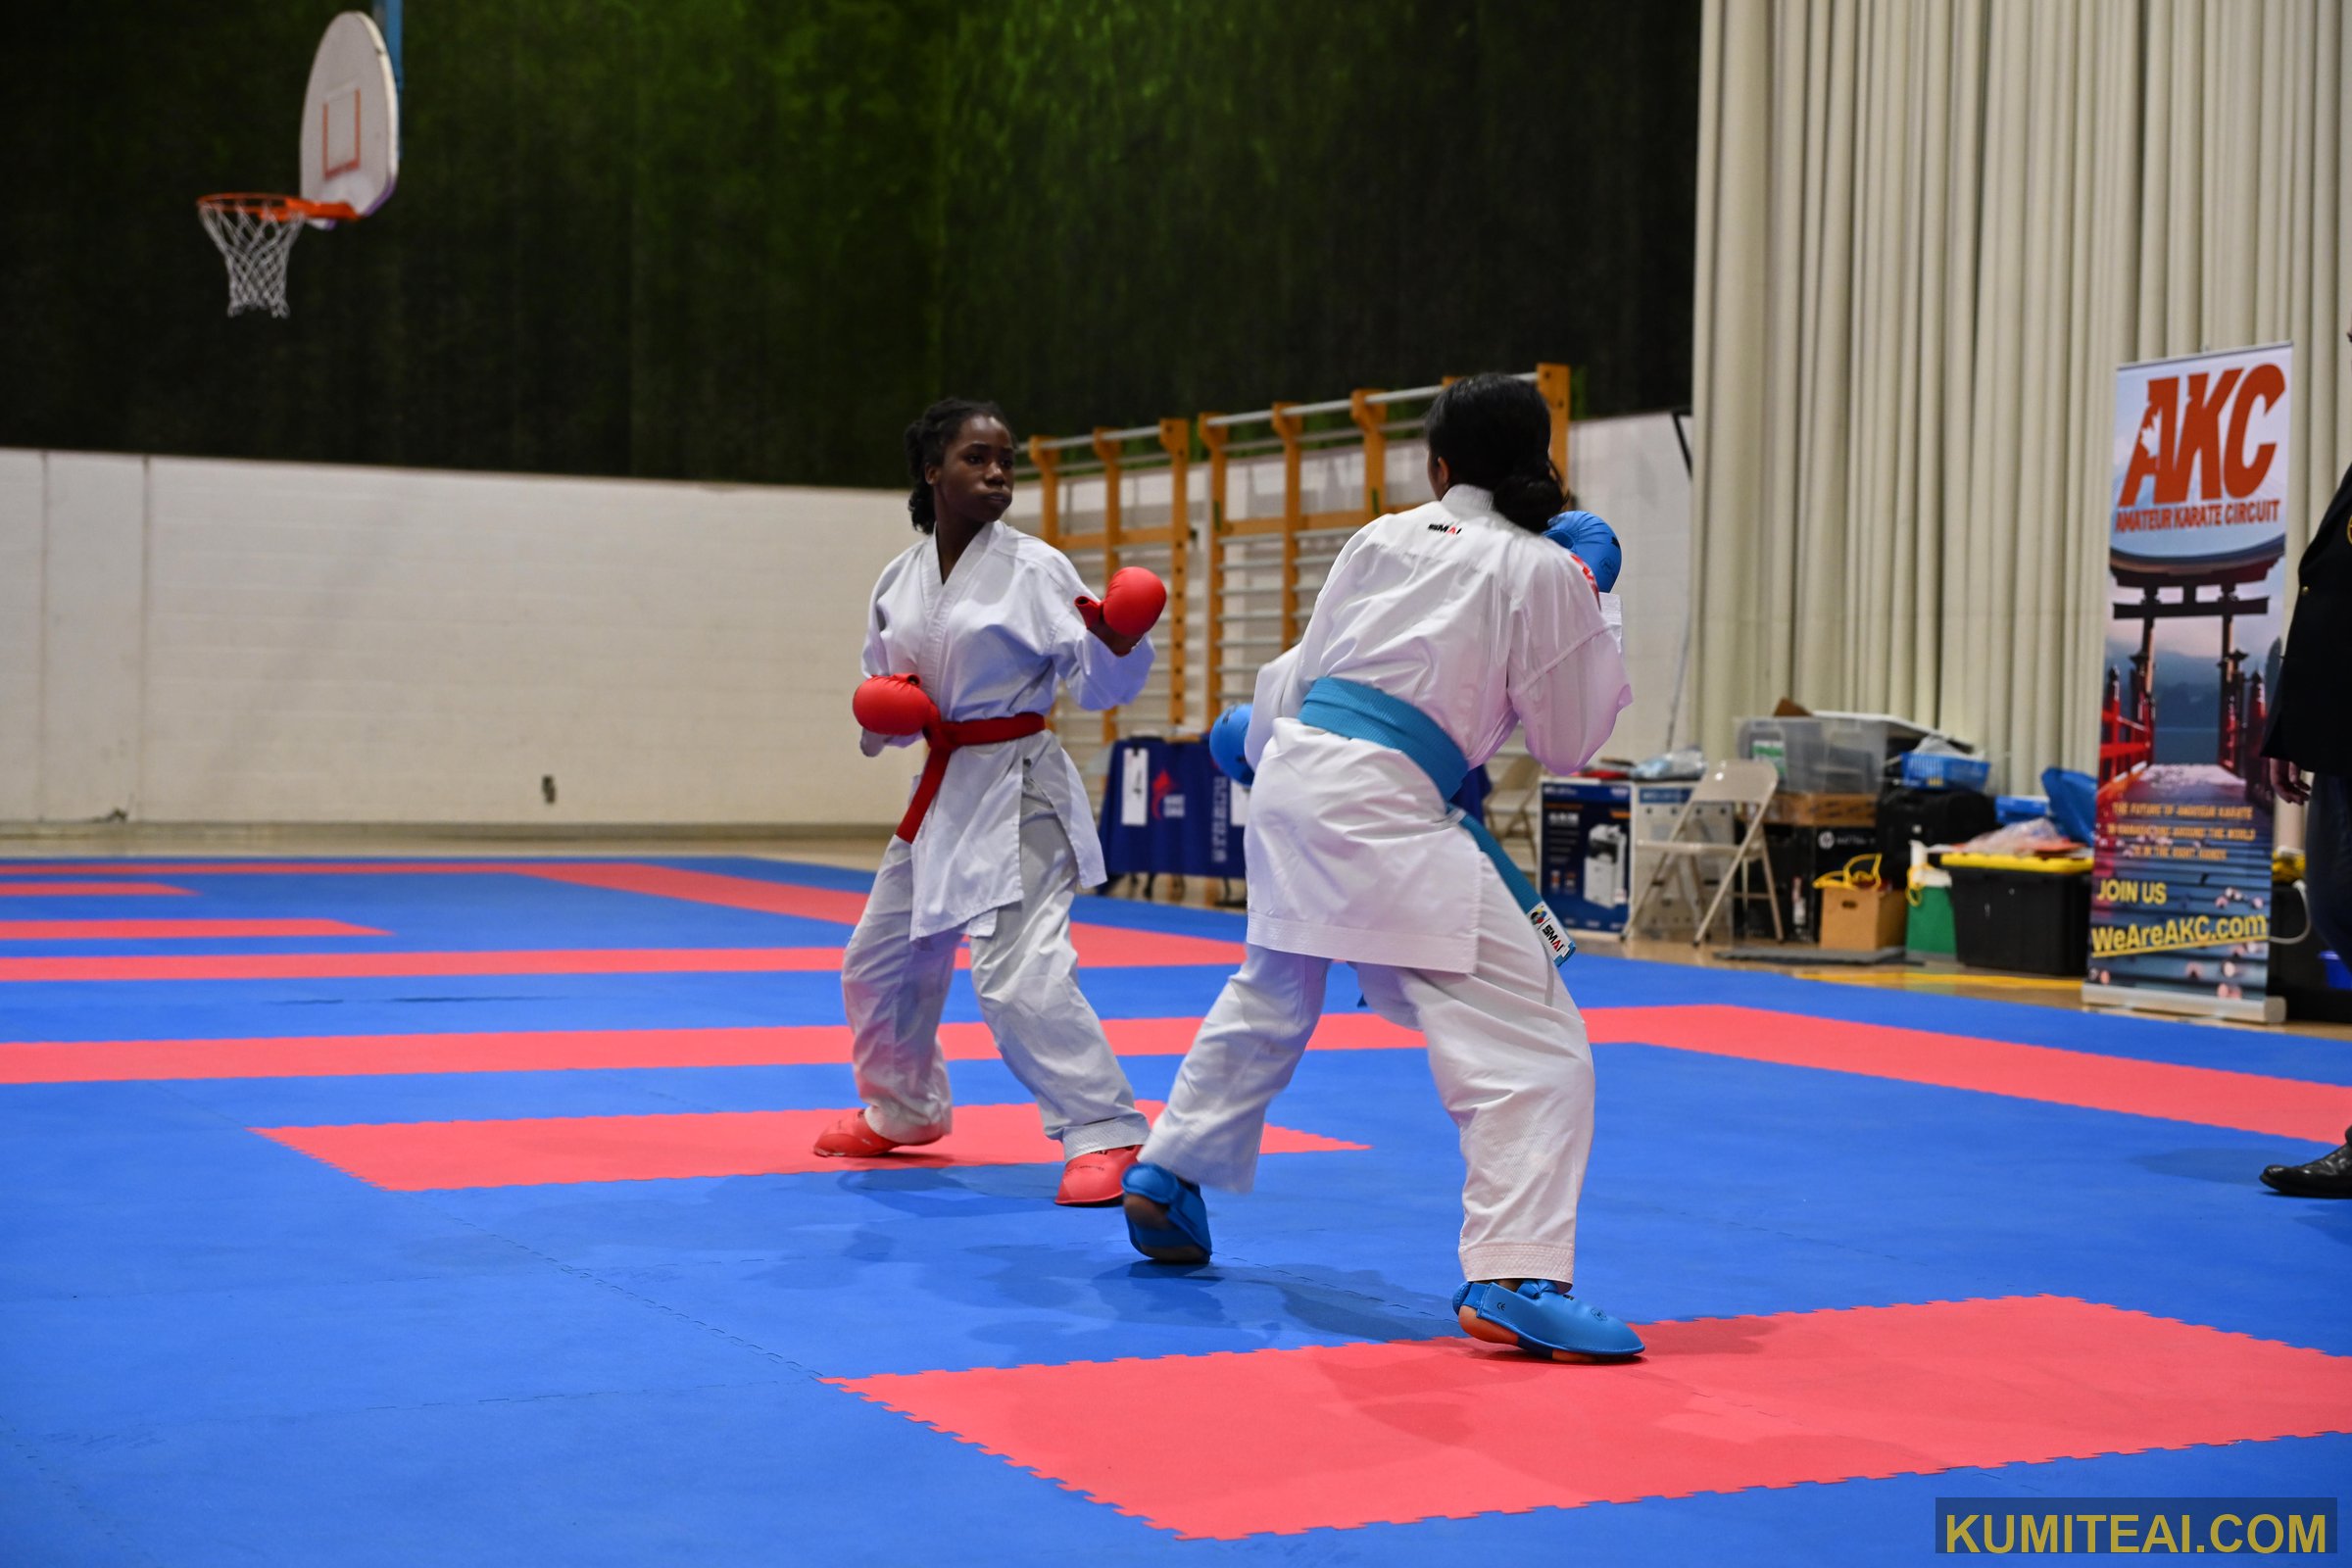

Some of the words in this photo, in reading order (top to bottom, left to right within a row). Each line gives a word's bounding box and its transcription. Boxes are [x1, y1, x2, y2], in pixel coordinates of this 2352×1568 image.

[2118, 363, 2285, 508] AKC
[2115, 509, 2172, 533] AMATEUR
[2175, 505, 2222, 530] KARATE
[2225, 500, 2279, 524] CIRCUIT
[2097, 879, 2138, 903] JOIN
[2141, 882, 2167, 905] US
[1542, 924, 1565, 953] SMAI
[2091, 914, 2269, 954] WeAreAKC.com
